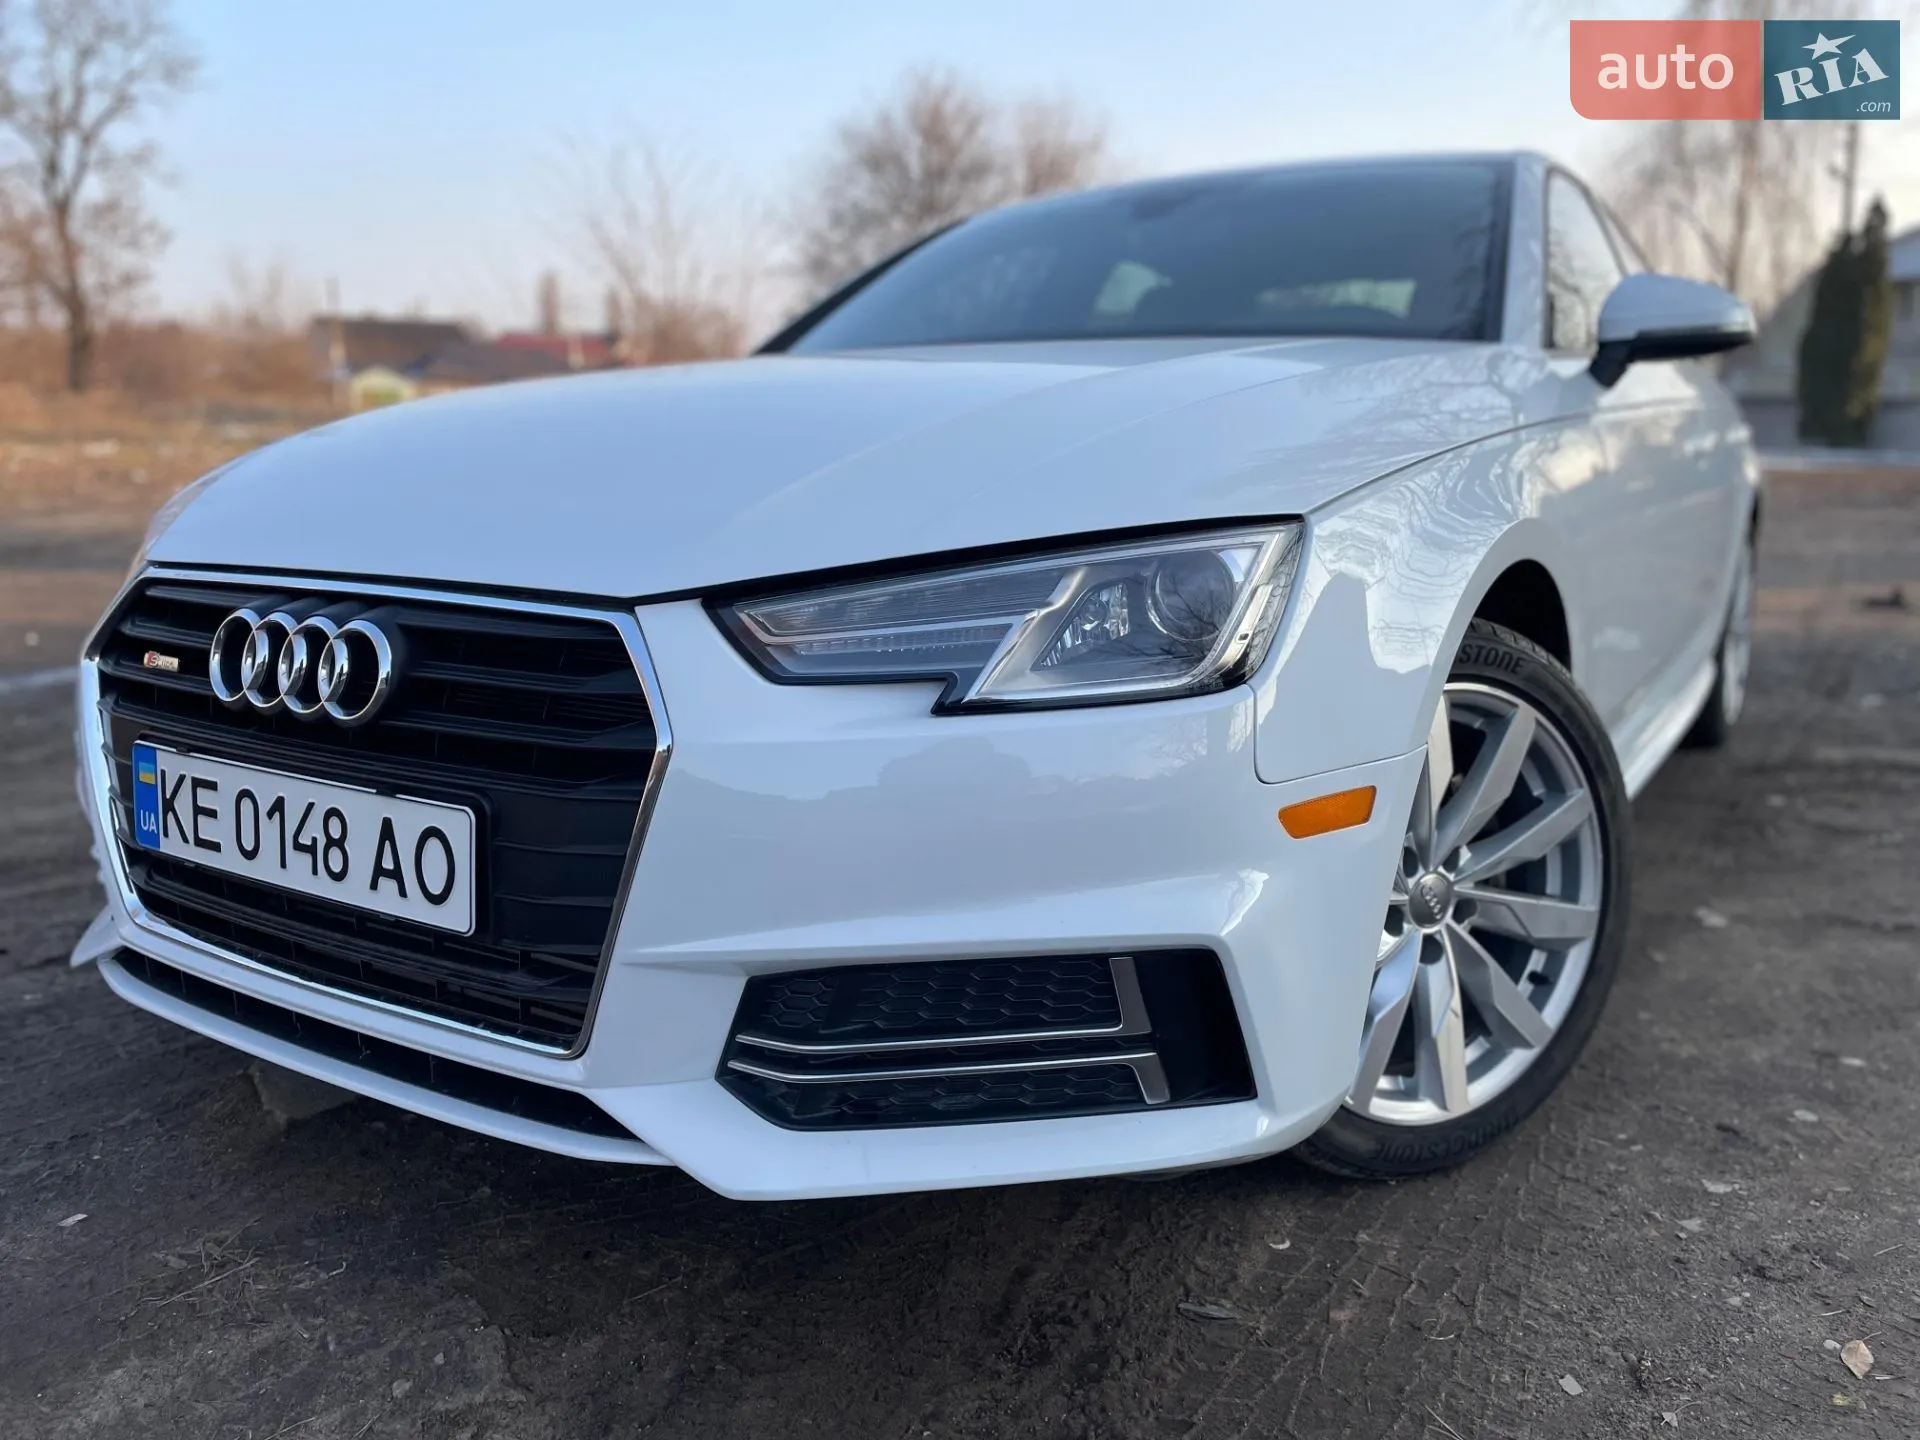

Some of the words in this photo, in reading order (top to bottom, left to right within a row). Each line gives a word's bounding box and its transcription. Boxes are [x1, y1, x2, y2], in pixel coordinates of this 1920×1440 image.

[1455, 643, 1527, 675] STONE
[140, 808, 158, 834] UA
[160, 768, 222, 853] KE
[234, 787, 350, 882] 0148
[369, 816, 456, 906] AO
